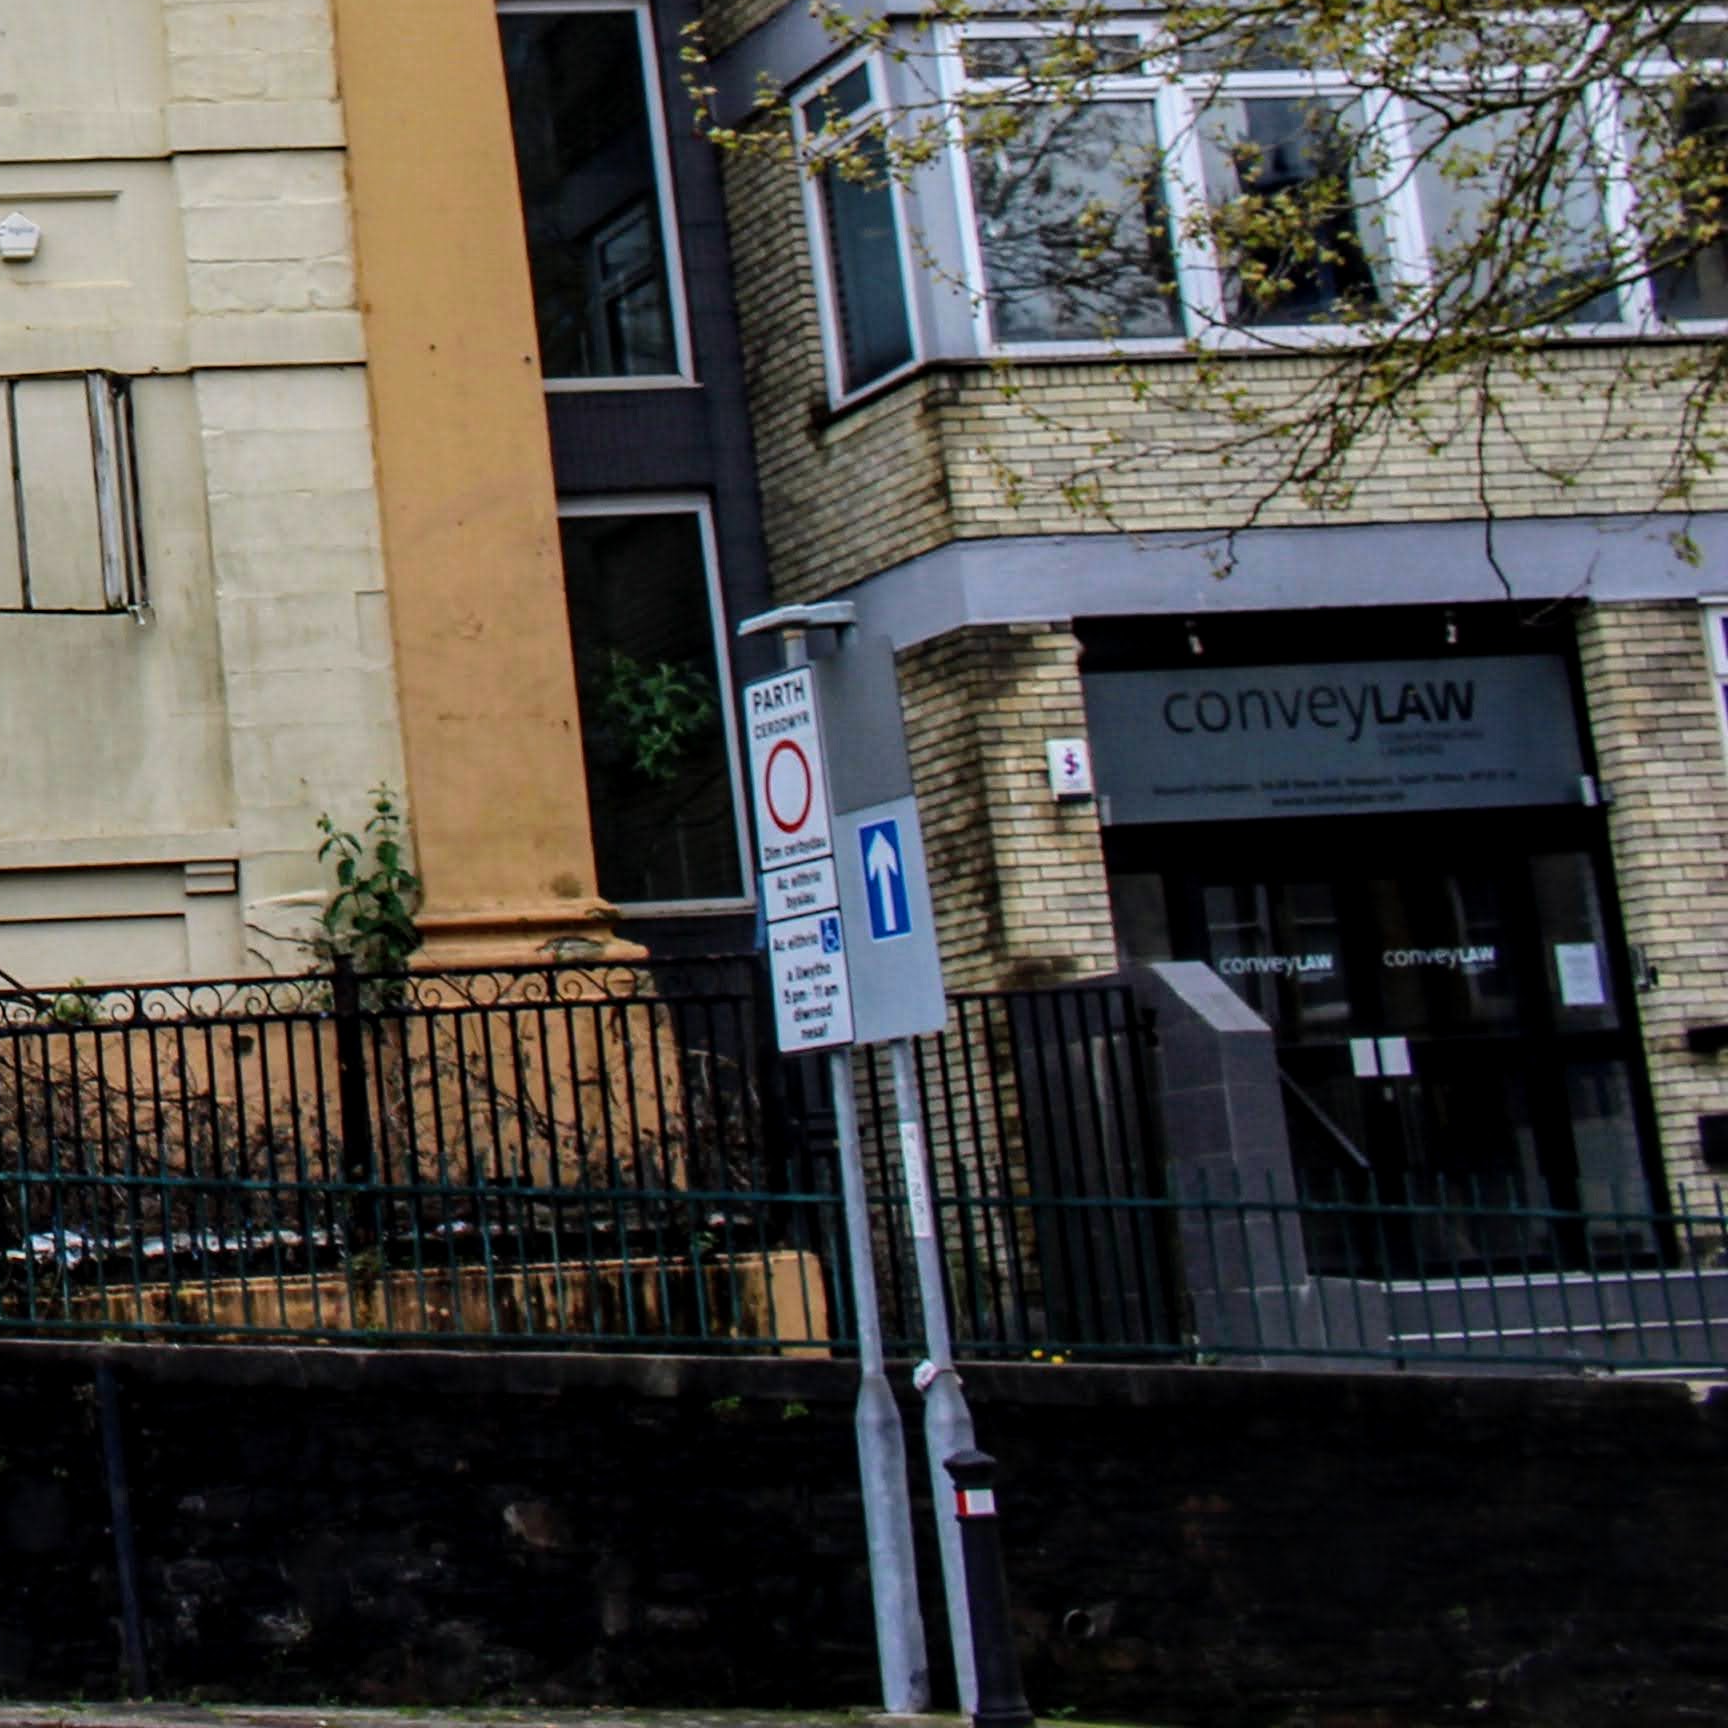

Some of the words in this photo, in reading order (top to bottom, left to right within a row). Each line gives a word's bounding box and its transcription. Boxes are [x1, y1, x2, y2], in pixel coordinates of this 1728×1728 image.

[752, 676, 806, 714] PARTH
[1162, 679, 1475, 743] conveyLAW
[1219, 953, 1334, 978] conveyLAW
[1382, 945, 1496, 970] conveyLAW
